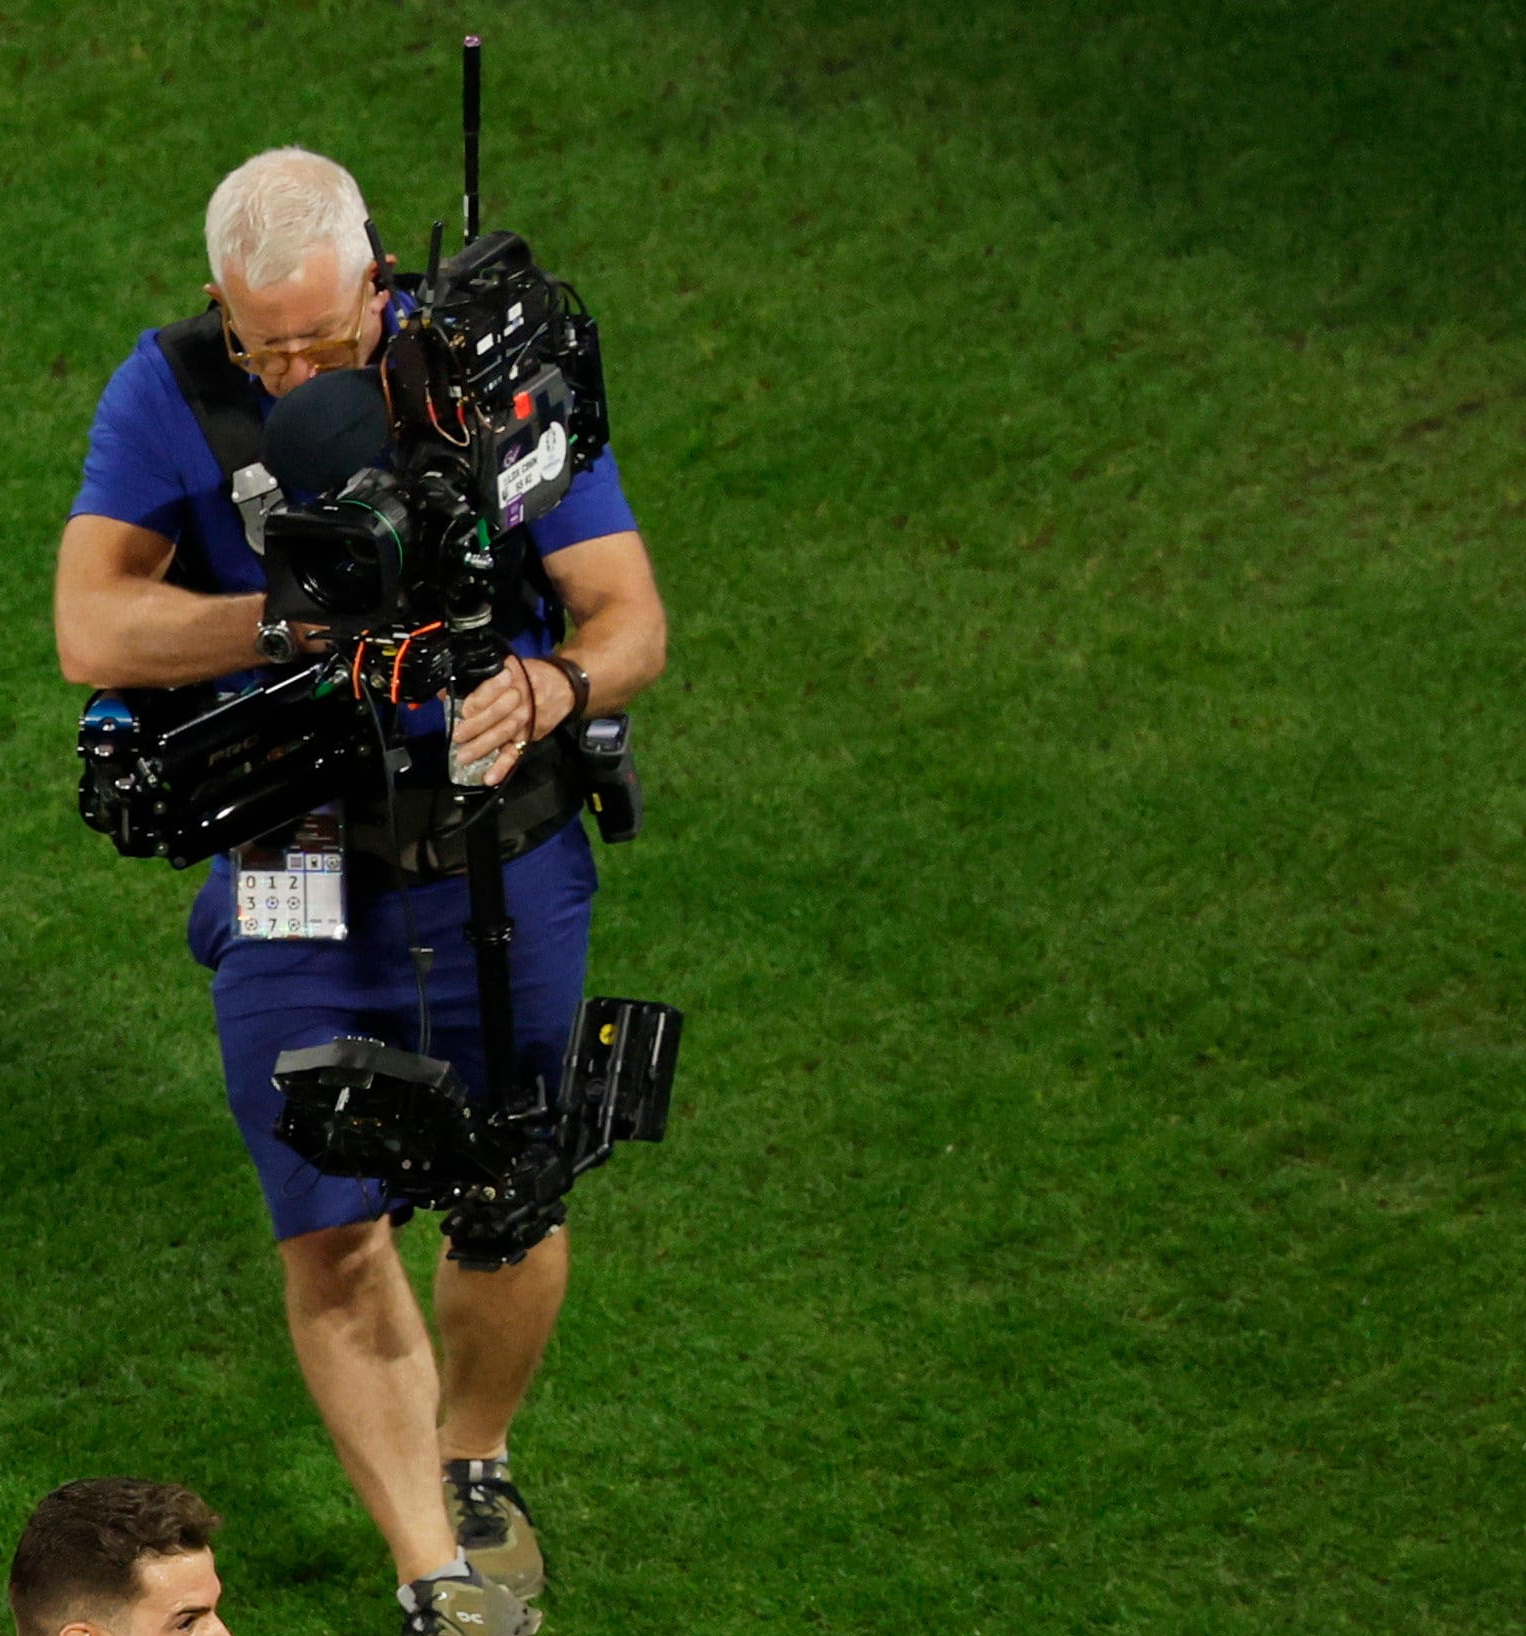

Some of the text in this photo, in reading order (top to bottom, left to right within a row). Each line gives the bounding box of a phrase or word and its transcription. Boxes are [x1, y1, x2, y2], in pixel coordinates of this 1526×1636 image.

[246, 875, 298, 890] 0 1 2
[246, 896, 256, 910] 3
[268, 918, 278, 932] 7
